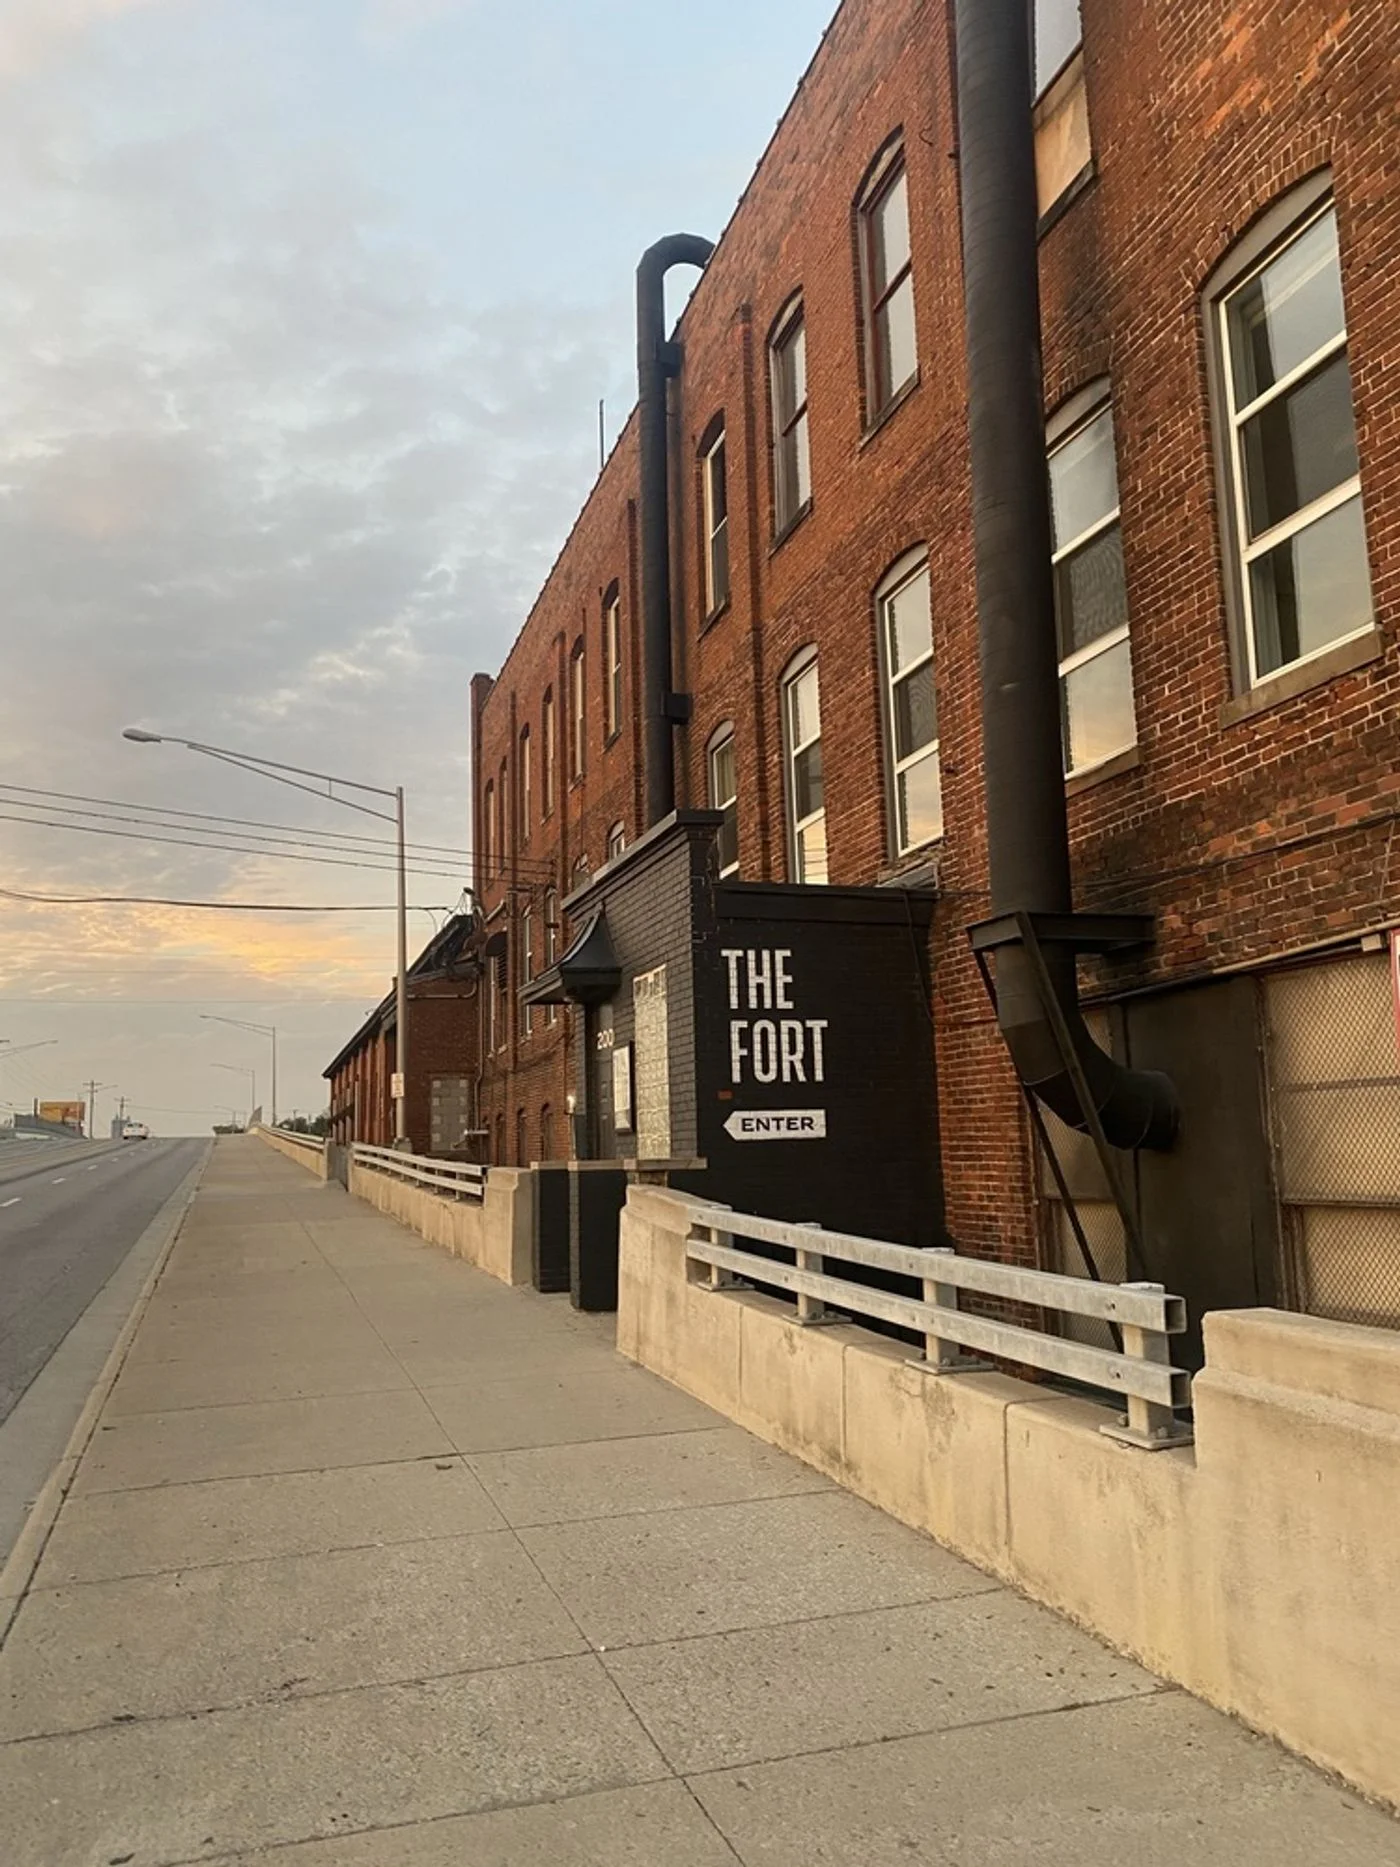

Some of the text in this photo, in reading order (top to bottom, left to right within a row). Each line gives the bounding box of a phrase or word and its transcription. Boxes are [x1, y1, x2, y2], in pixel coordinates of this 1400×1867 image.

[721, 949, 794, 1010] THE
[597, 1029, 615, 1050] 200
[730, 1019, 828, 1083] FORT
[741, 1116, 815, 1132] ENTER
